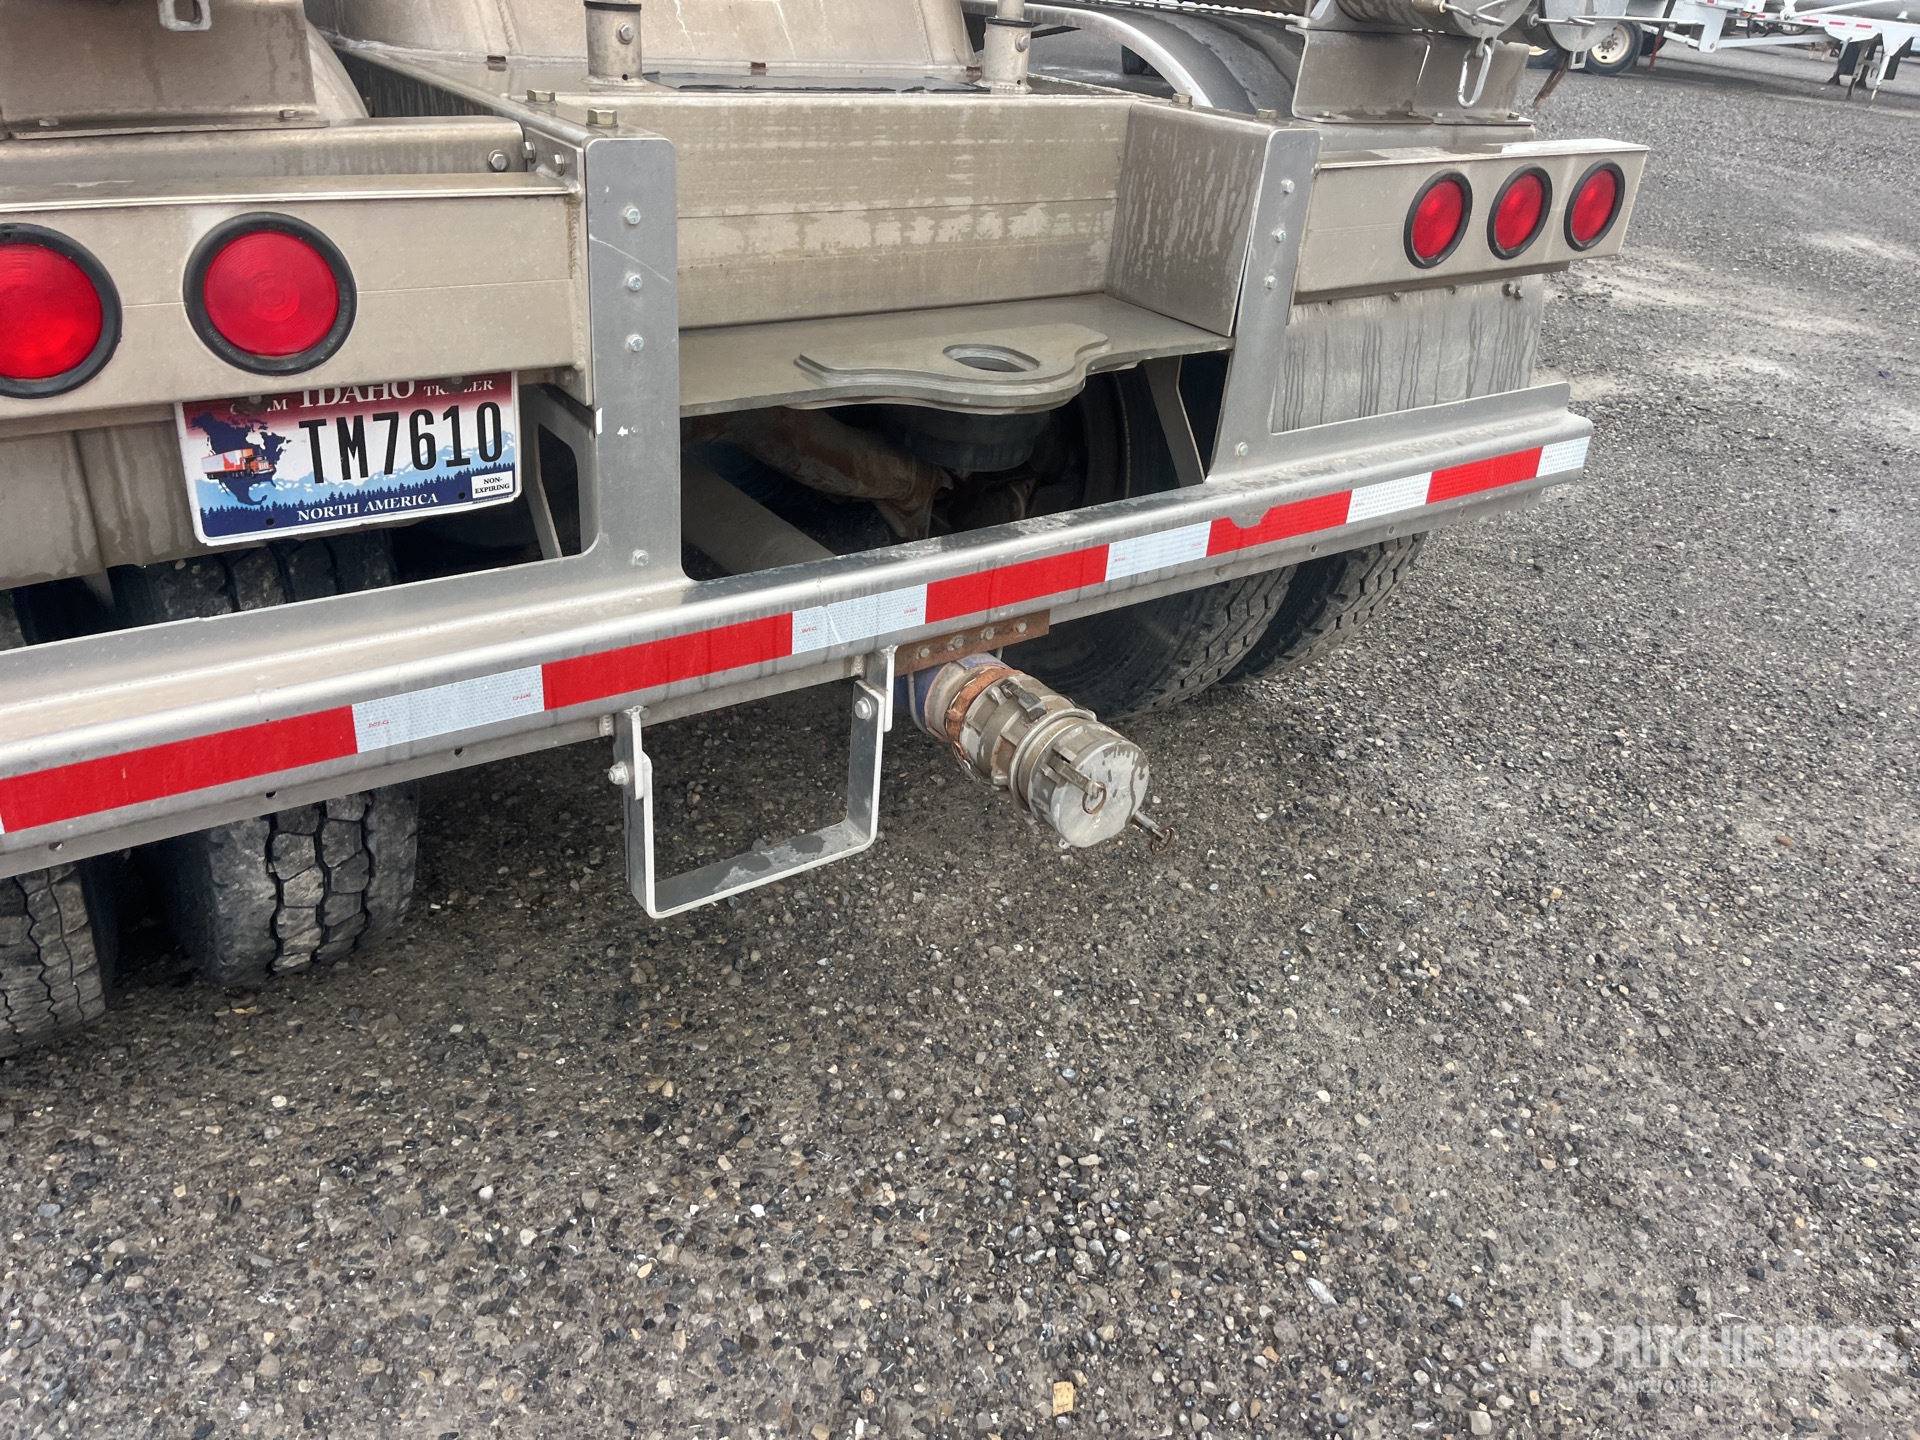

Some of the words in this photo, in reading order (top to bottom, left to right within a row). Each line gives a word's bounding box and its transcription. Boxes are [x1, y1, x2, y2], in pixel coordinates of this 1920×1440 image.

[299, 379, 415, 408] IDAHO
[423, 380, 494, 396] TRER
[299, 402, 502, 484] TM7610
[475, 483, 510, 494] EXPIRING
[483, 476, 503, 485] NON-
[297, 503, 359, 522] NORTH
[364, 492, 439, 512] AMERICA
